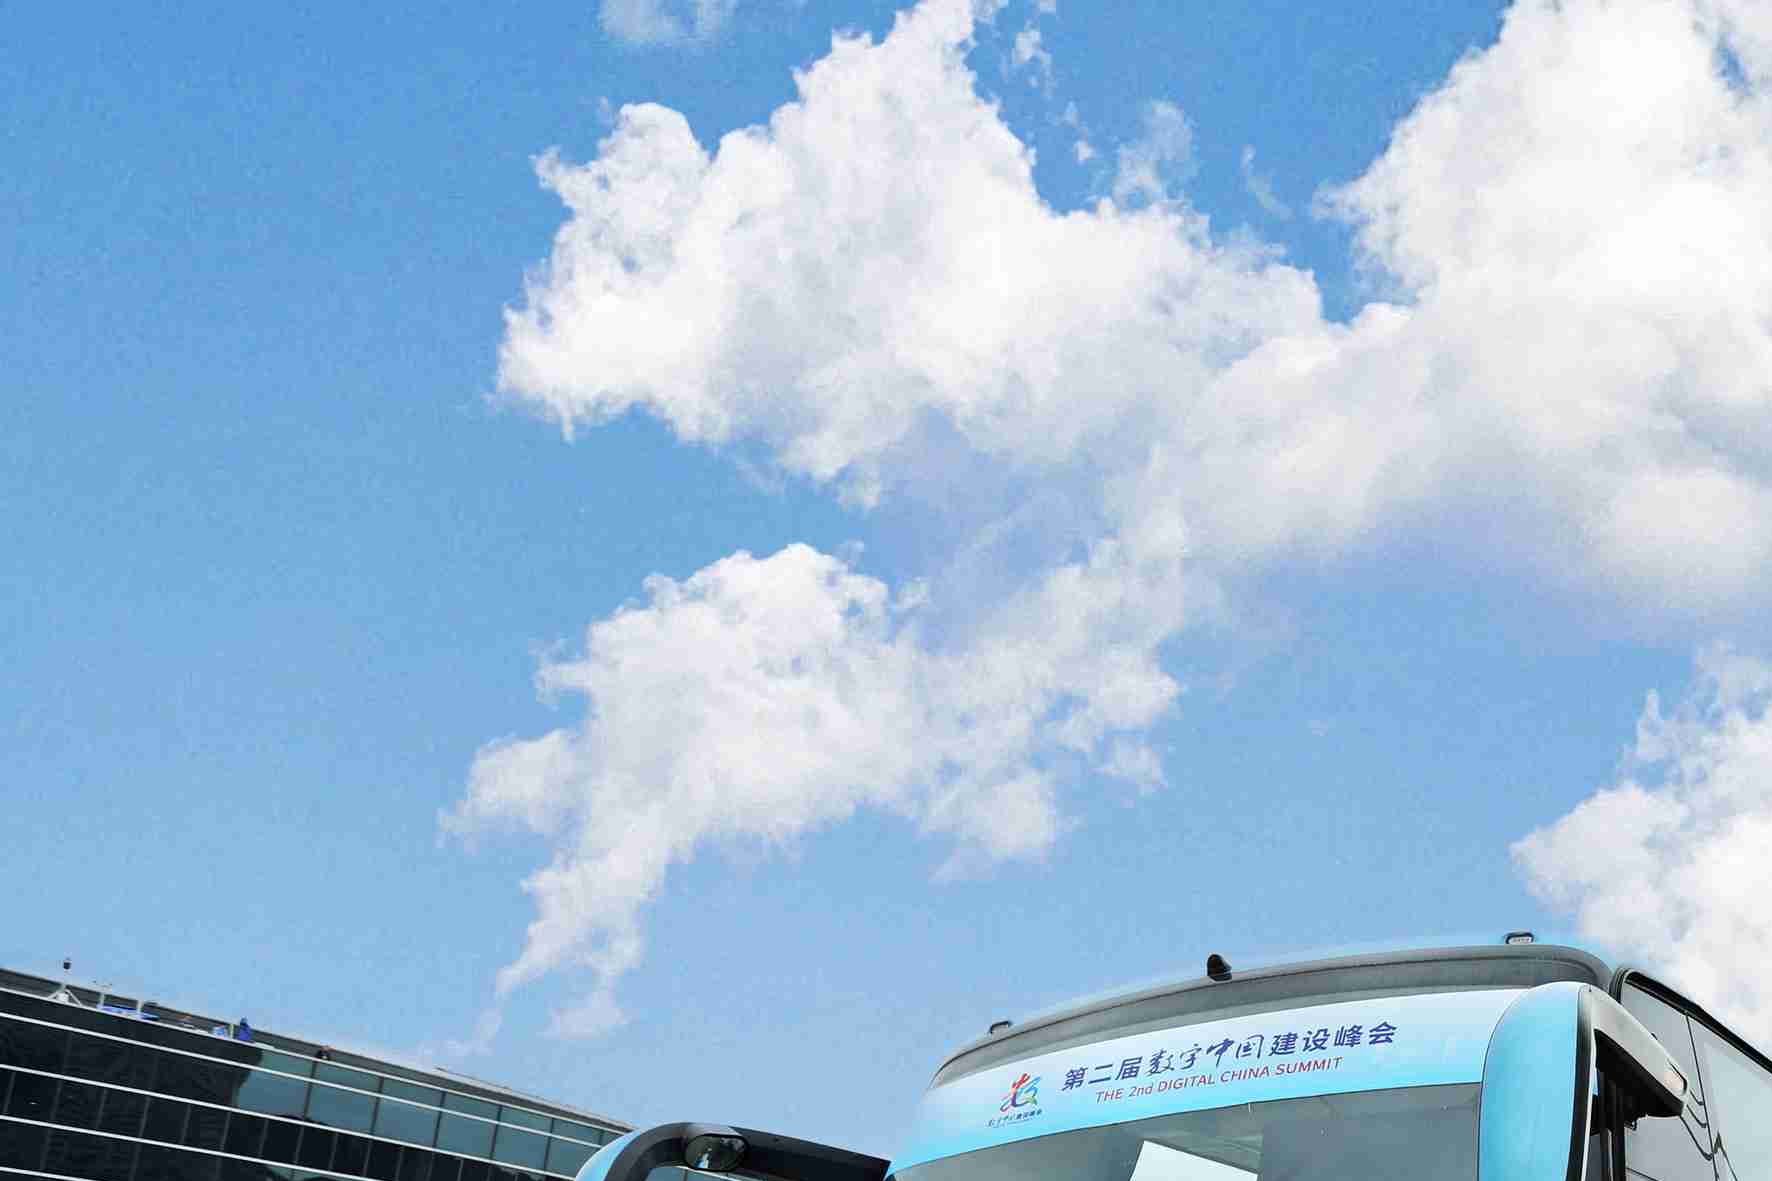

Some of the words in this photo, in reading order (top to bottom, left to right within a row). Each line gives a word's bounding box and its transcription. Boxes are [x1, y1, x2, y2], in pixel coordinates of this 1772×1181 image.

[1062, 1021, 1397, 1091] 第二届数字中国建设峰会
[1095, 1087, 1124, 1104] THE
[1128, 1083, 1154, 1098] 2nd
[1157, 1073, 1216, 1093] DIGITAL
[1219, 1066, 1272, 1085] CHINA
[1275, 1055, 1345, 1076] SUMMIT
